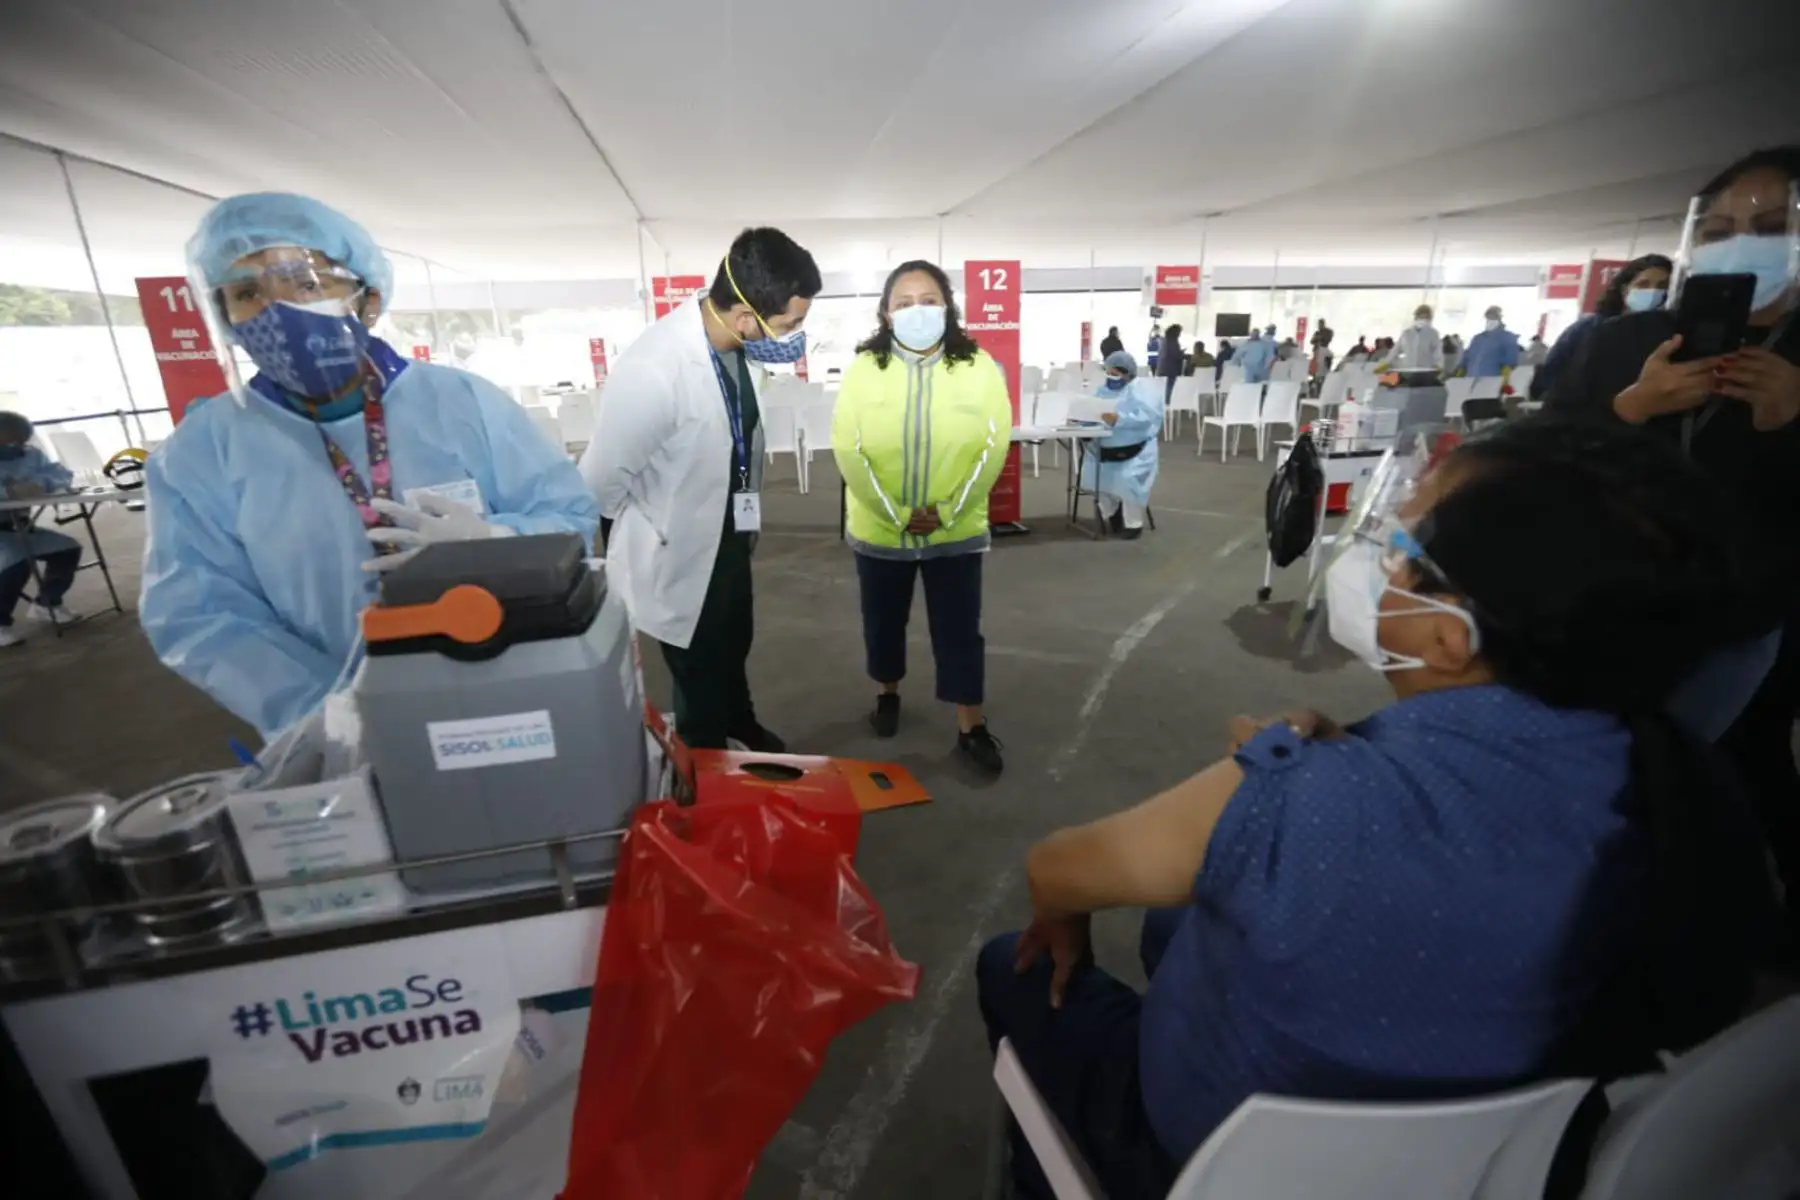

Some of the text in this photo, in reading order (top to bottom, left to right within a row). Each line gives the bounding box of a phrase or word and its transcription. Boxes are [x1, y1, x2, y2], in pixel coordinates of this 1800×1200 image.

[978, 268, 1008, 291] 12
[160, 286, 194, 313] 11
[438, 732, 553, 757] SISOL SALUD
[230, 974, 464, 1039] #LimaSe
[288, 1008, 482, 1064] Vacuna
[432, 1075, 485, 1103] LIMA
